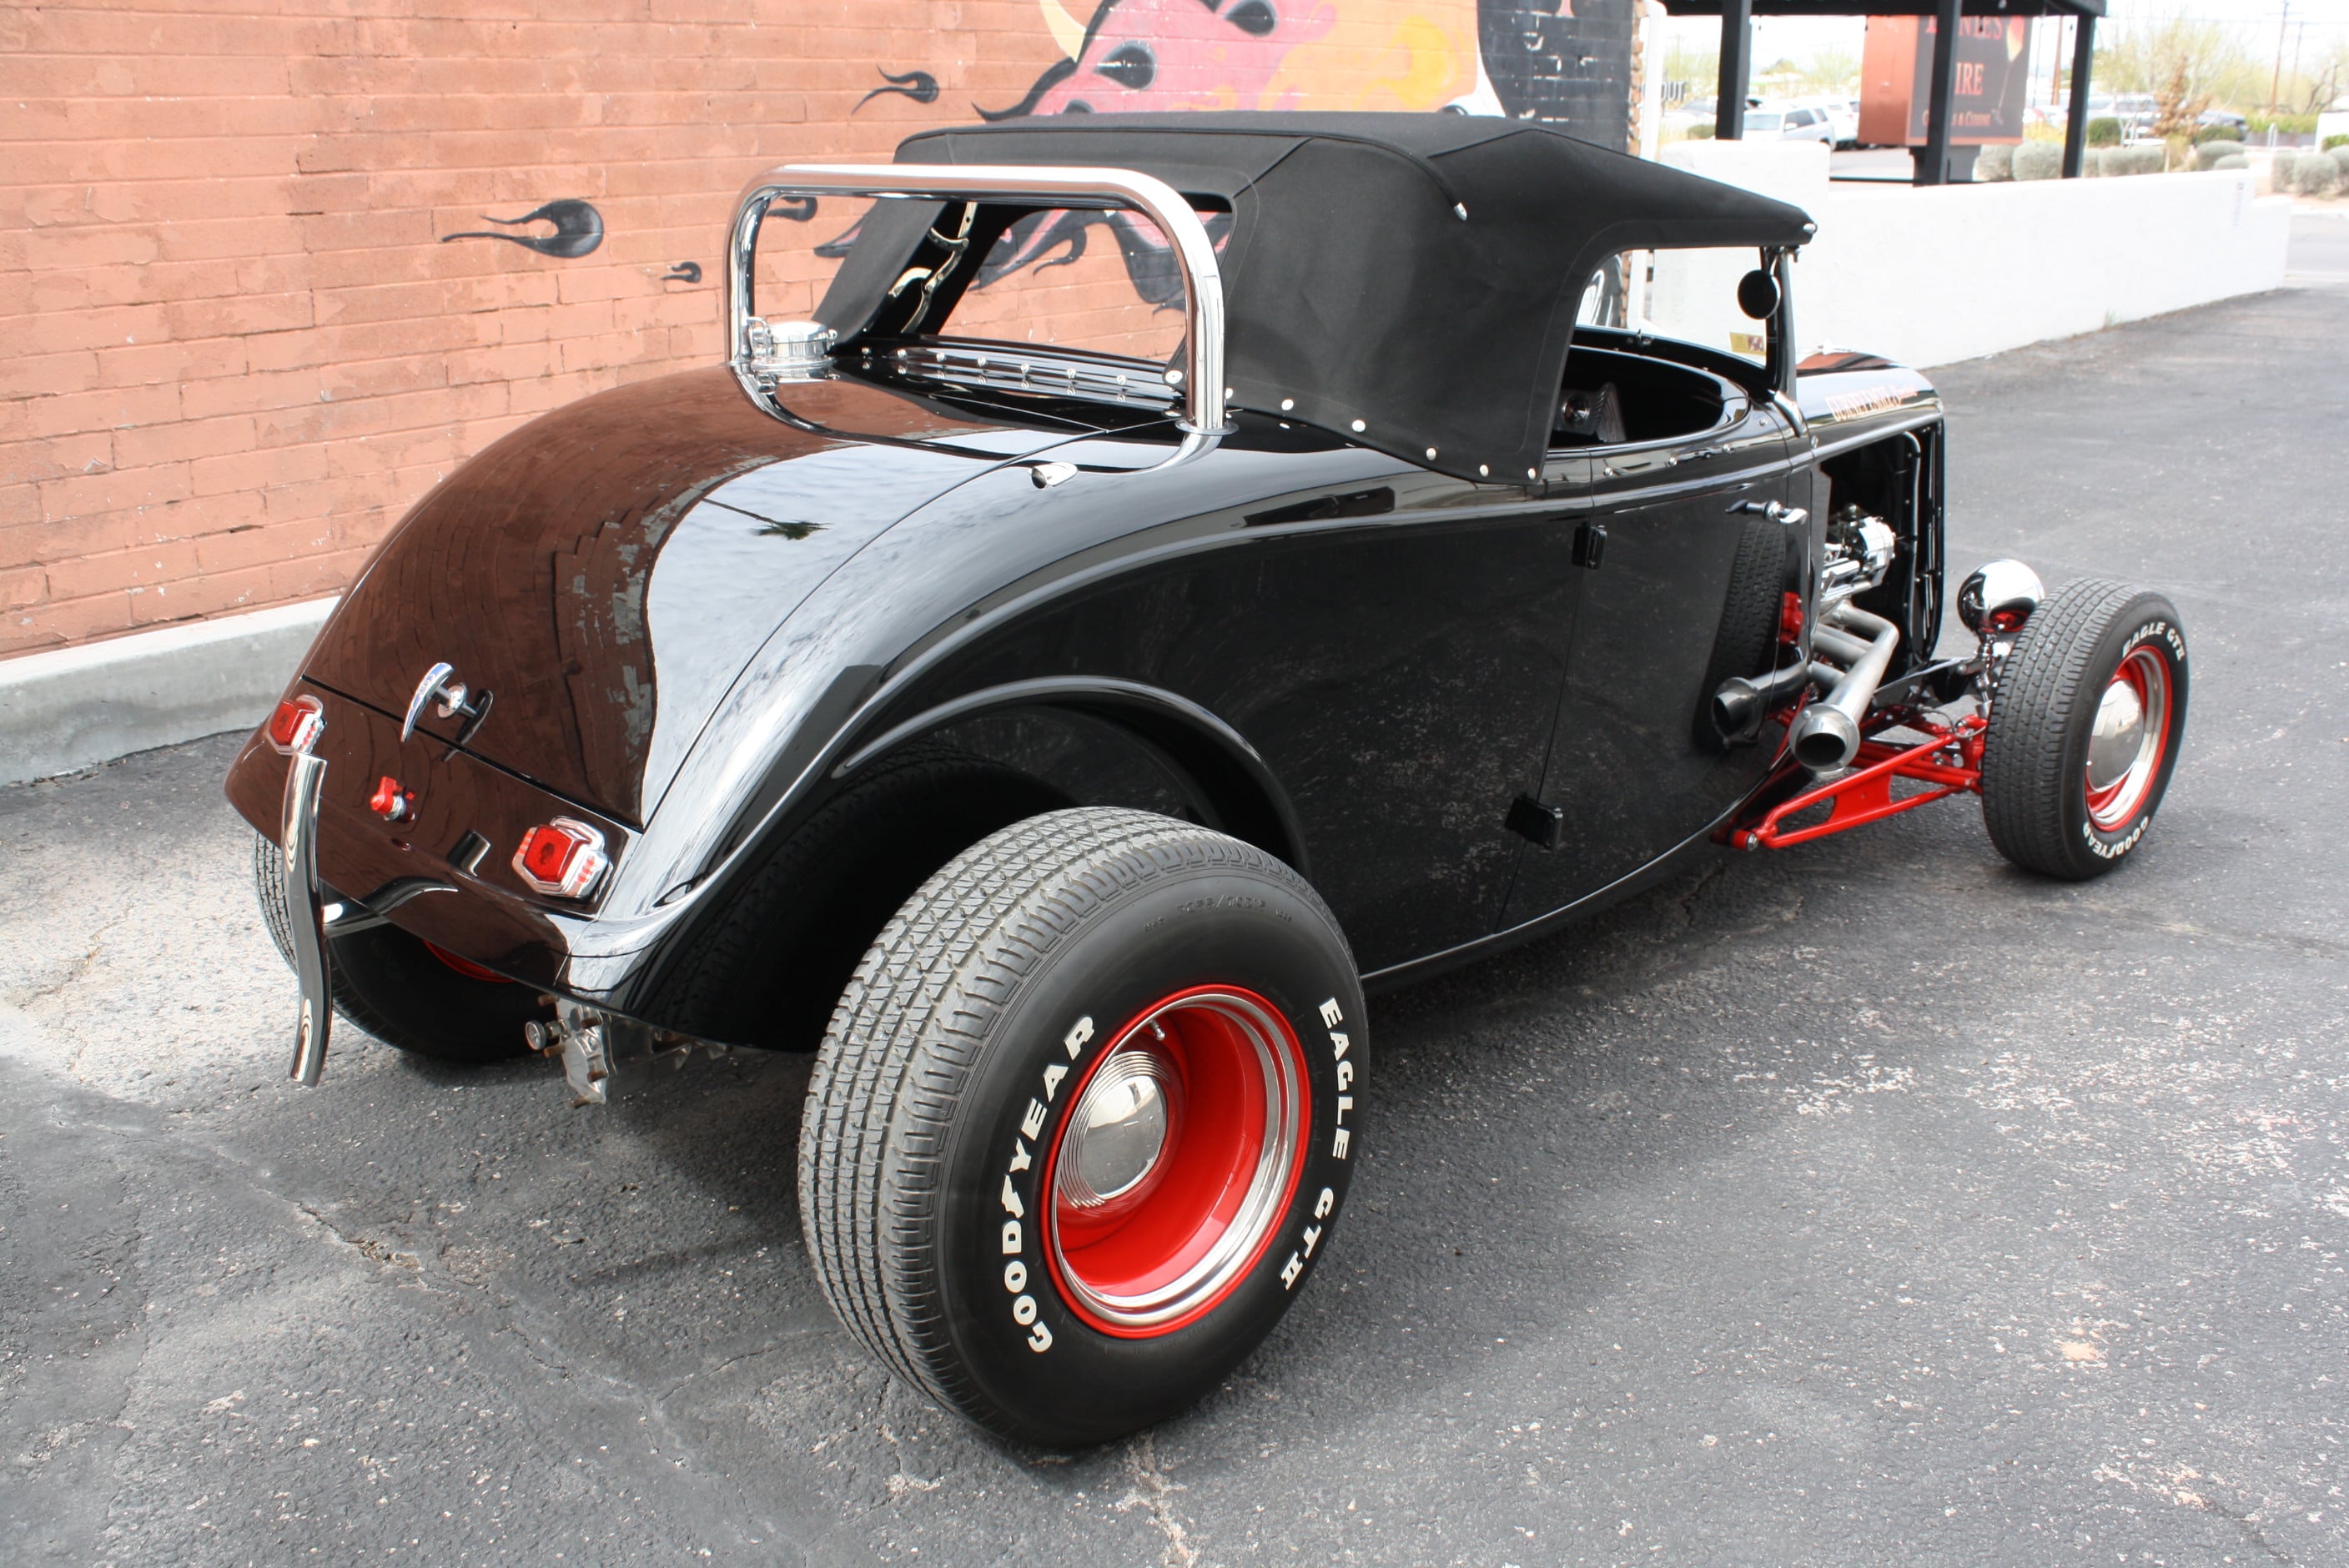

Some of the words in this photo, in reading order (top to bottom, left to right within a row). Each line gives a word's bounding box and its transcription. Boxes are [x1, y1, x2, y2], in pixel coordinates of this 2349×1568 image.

[2122, 621, 2166, 658] EAGLE
[2082, 816, 2149, 859] GOODYEAR
[1319, 997, 1354, 1161] EAGLE
[1001, 1015, 1095, 1354] GOODYEAR
